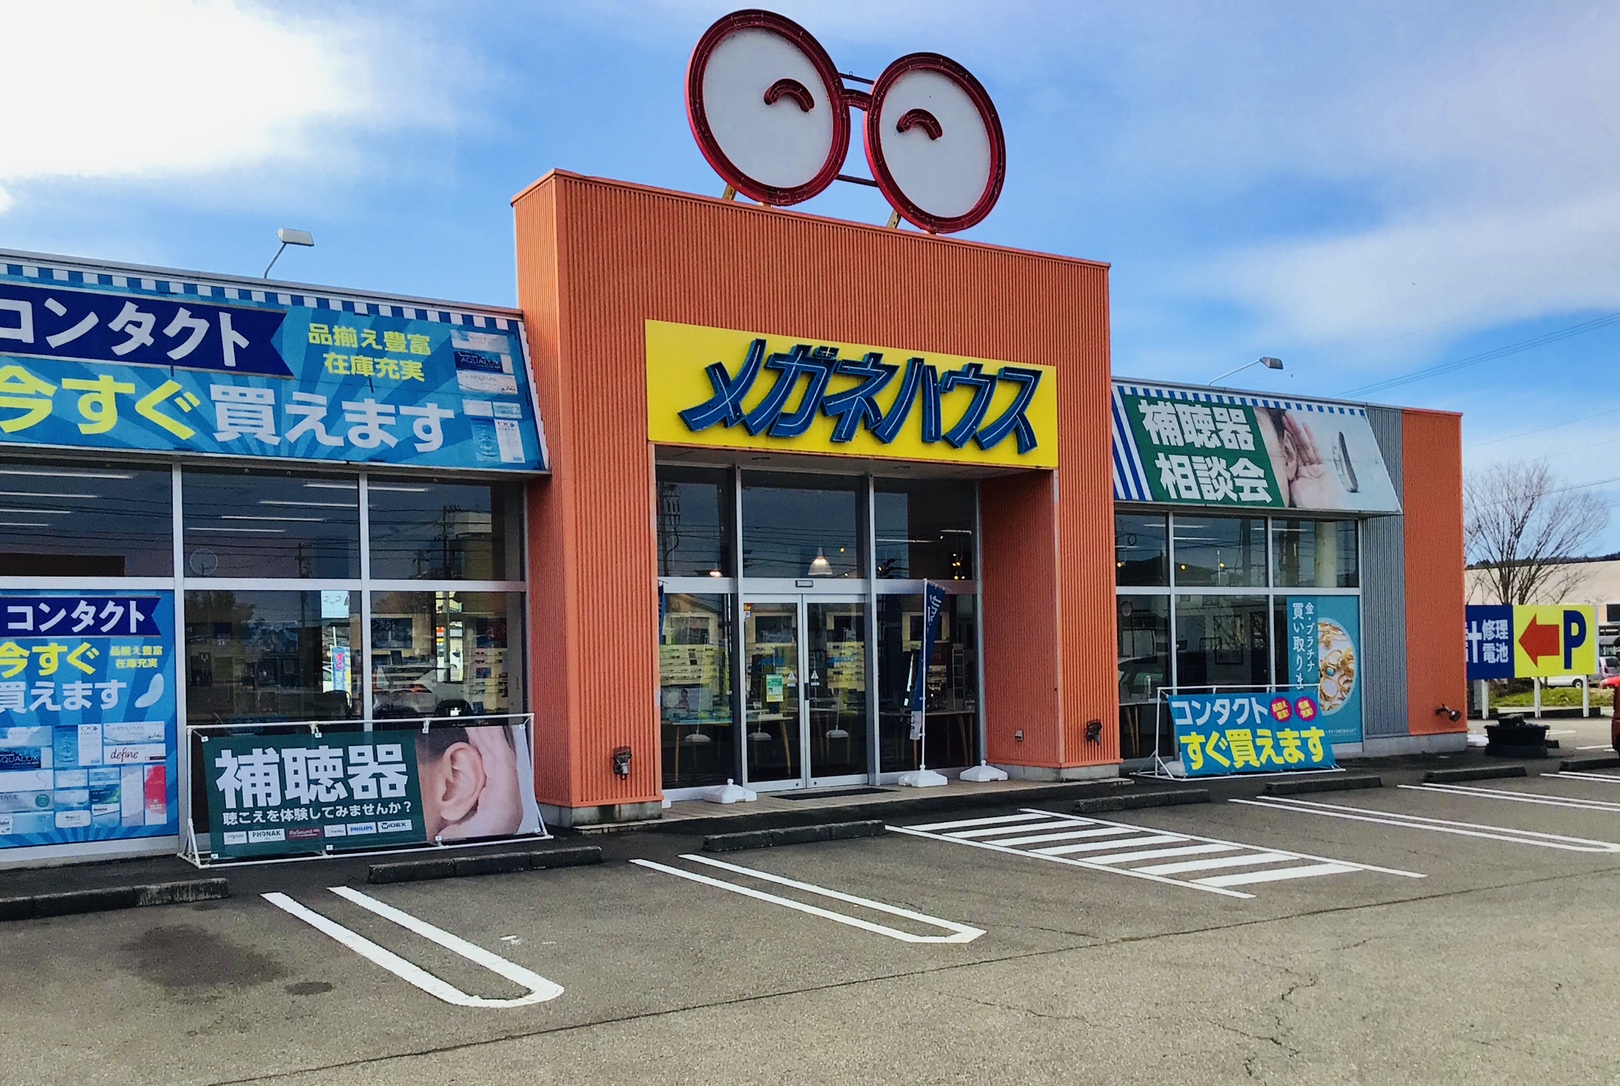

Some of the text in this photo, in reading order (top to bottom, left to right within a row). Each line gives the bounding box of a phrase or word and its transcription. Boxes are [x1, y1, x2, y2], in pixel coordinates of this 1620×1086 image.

[0, 297, 250, 367] コンタクト
[308, 322, 432, 356] 品揃え豊富
[322, 351, 425, 383] 在庫充実
[677, 337, 1043, 455] メガネハウス
[1138, 398, 1256, 451] 補聴器
[1154, 452, 1274, 504] 相談会
[7, 599, 146, 633] コンタクト
[1482, 619, 1509, 641] 修理
[1482, 642, 1509, 664] 電池
[1563, 609, 1587, 670] P
[0, 640, 100, 679] 今すぐ
[0, 678, 128, 715] 買えます
[1171, 697, 1269, 726] コンタクト
[0, 755, 40, 764] QUALOX
[110, 747, 139, 763] define
[1179, 726, 1325, 770] すぐ買えます
[215, 743, 409, 810] 補聴器
[222, 800, 412, 827] 聴こえを体験してみませんか？
[381, 821, 407, 830] WIDEX
[252, 829, 281, 838] PHONAK
